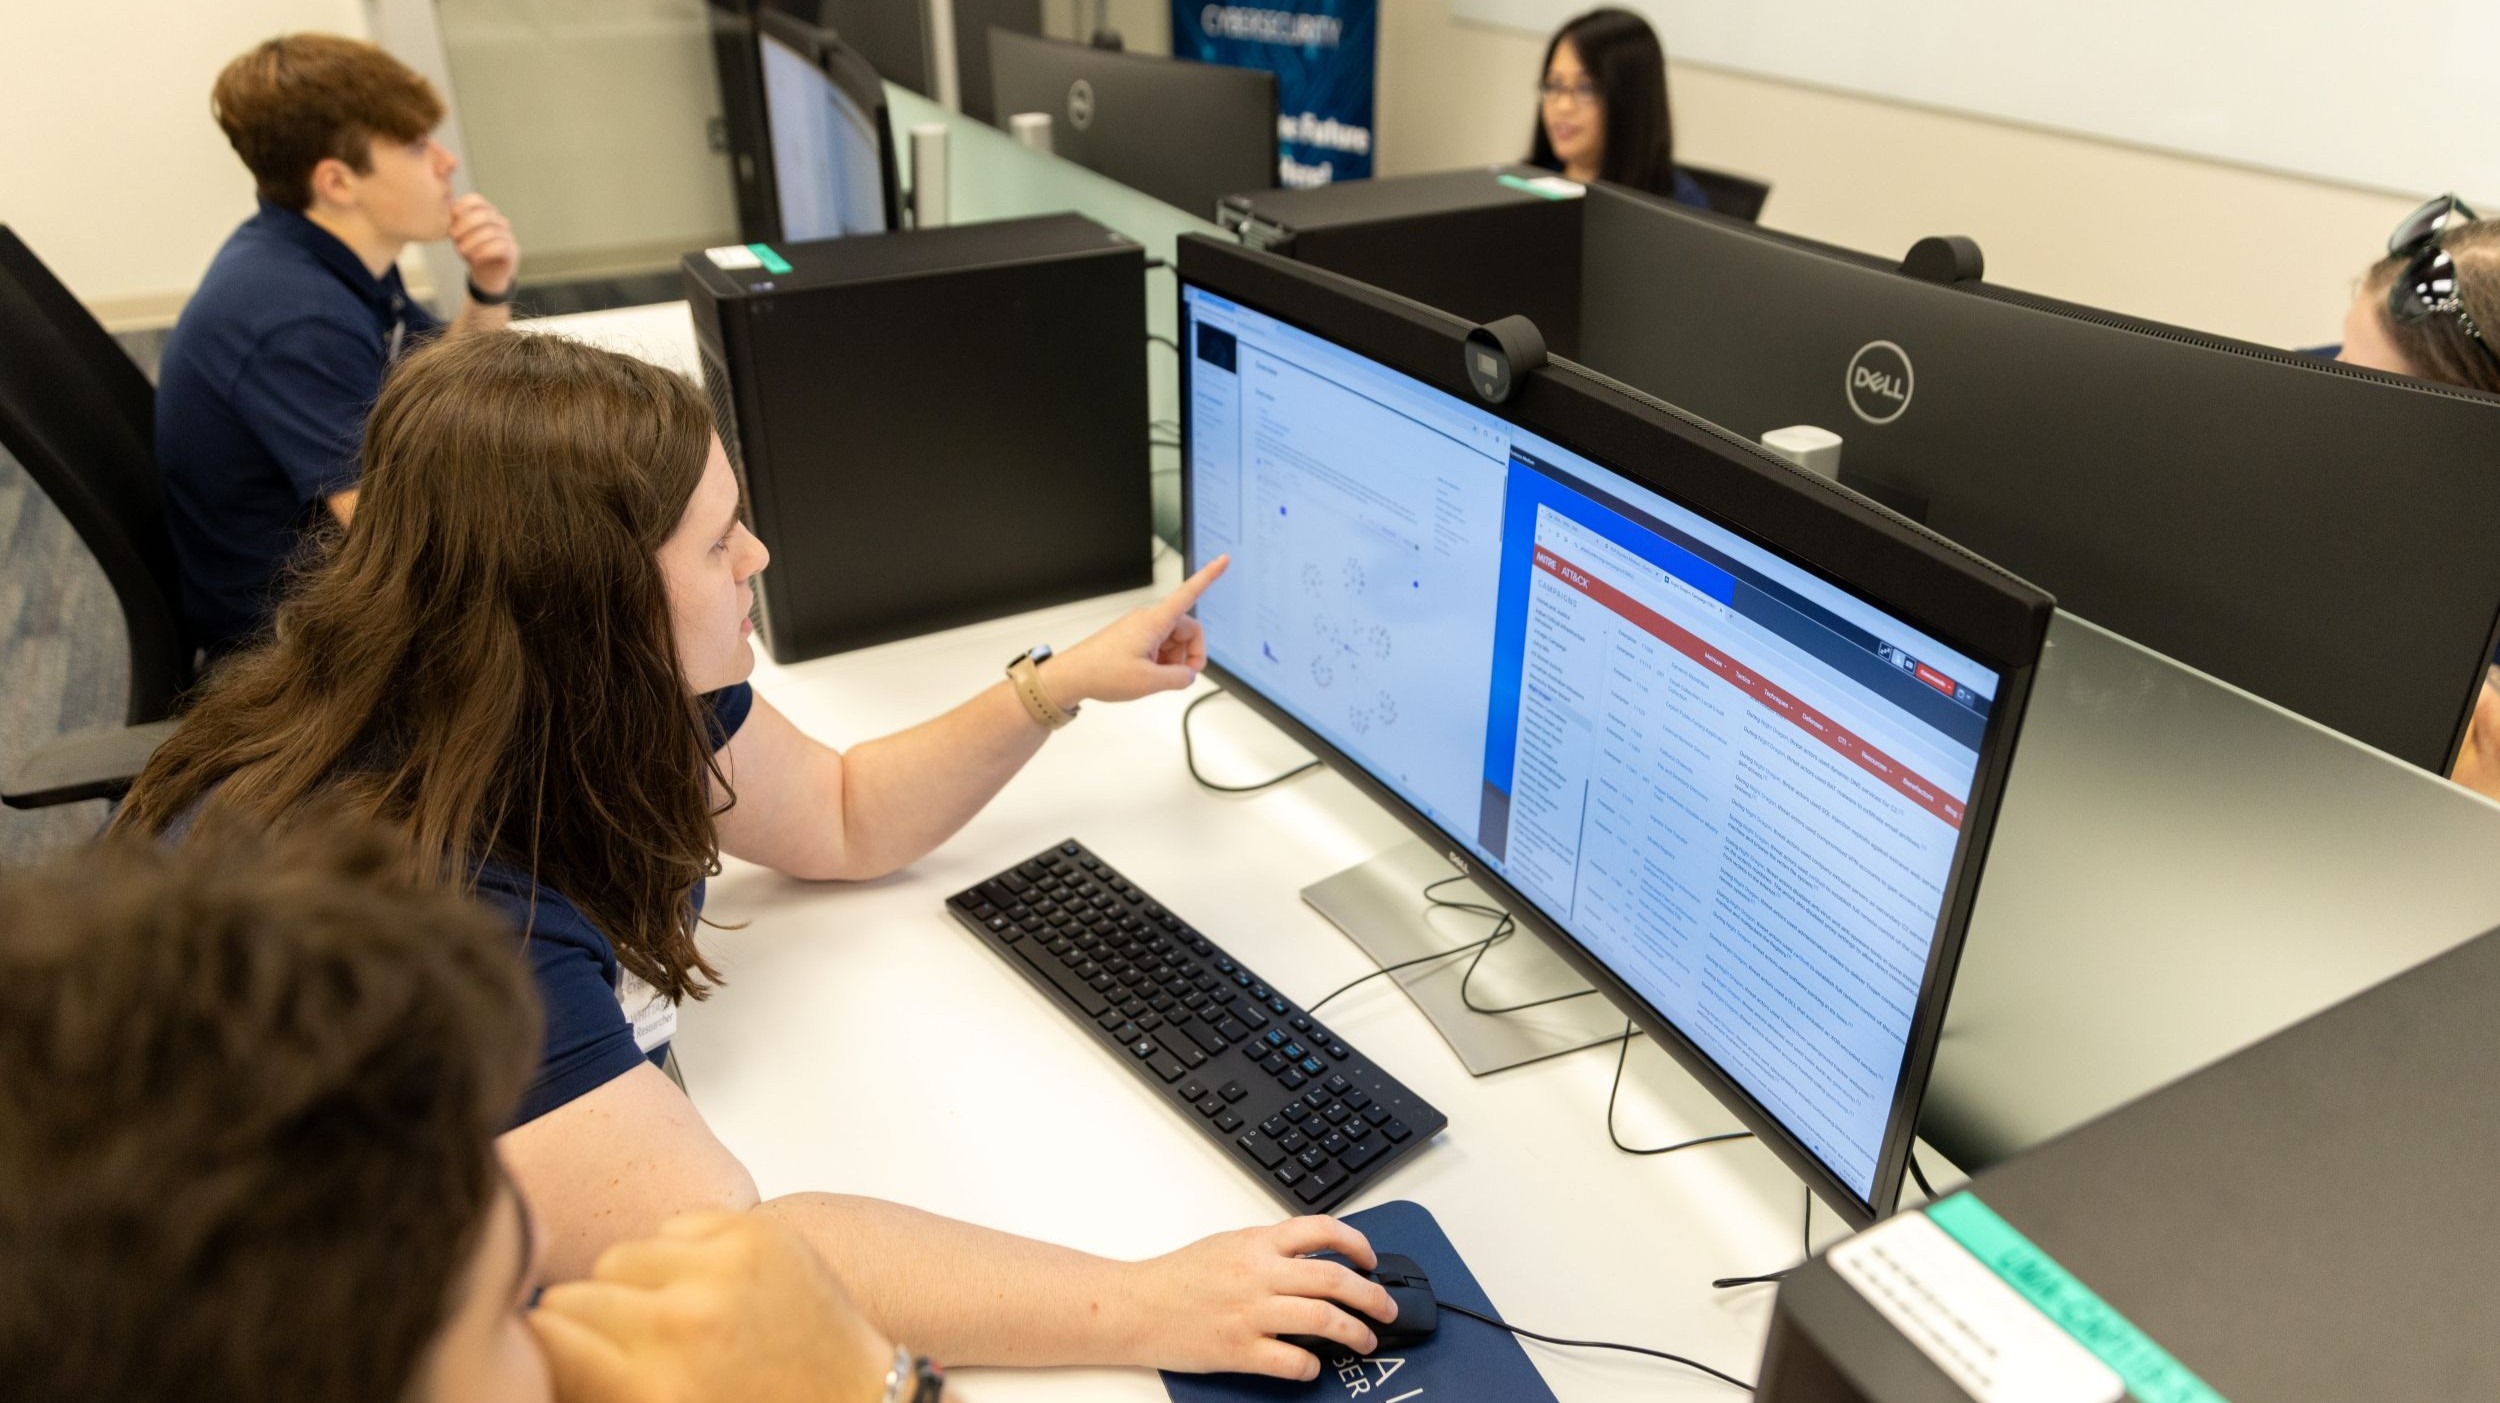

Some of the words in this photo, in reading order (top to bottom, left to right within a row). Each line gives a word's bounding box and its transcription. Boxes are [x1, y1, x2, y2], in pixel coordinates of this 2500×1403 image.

[1854, 366, 1904, 400] DELL
[1536, 549, 1557, 571] MITRE
[1561, 564, 1588, 590] ATT&CK
[1763, 688, 1788, 710] Techniques
